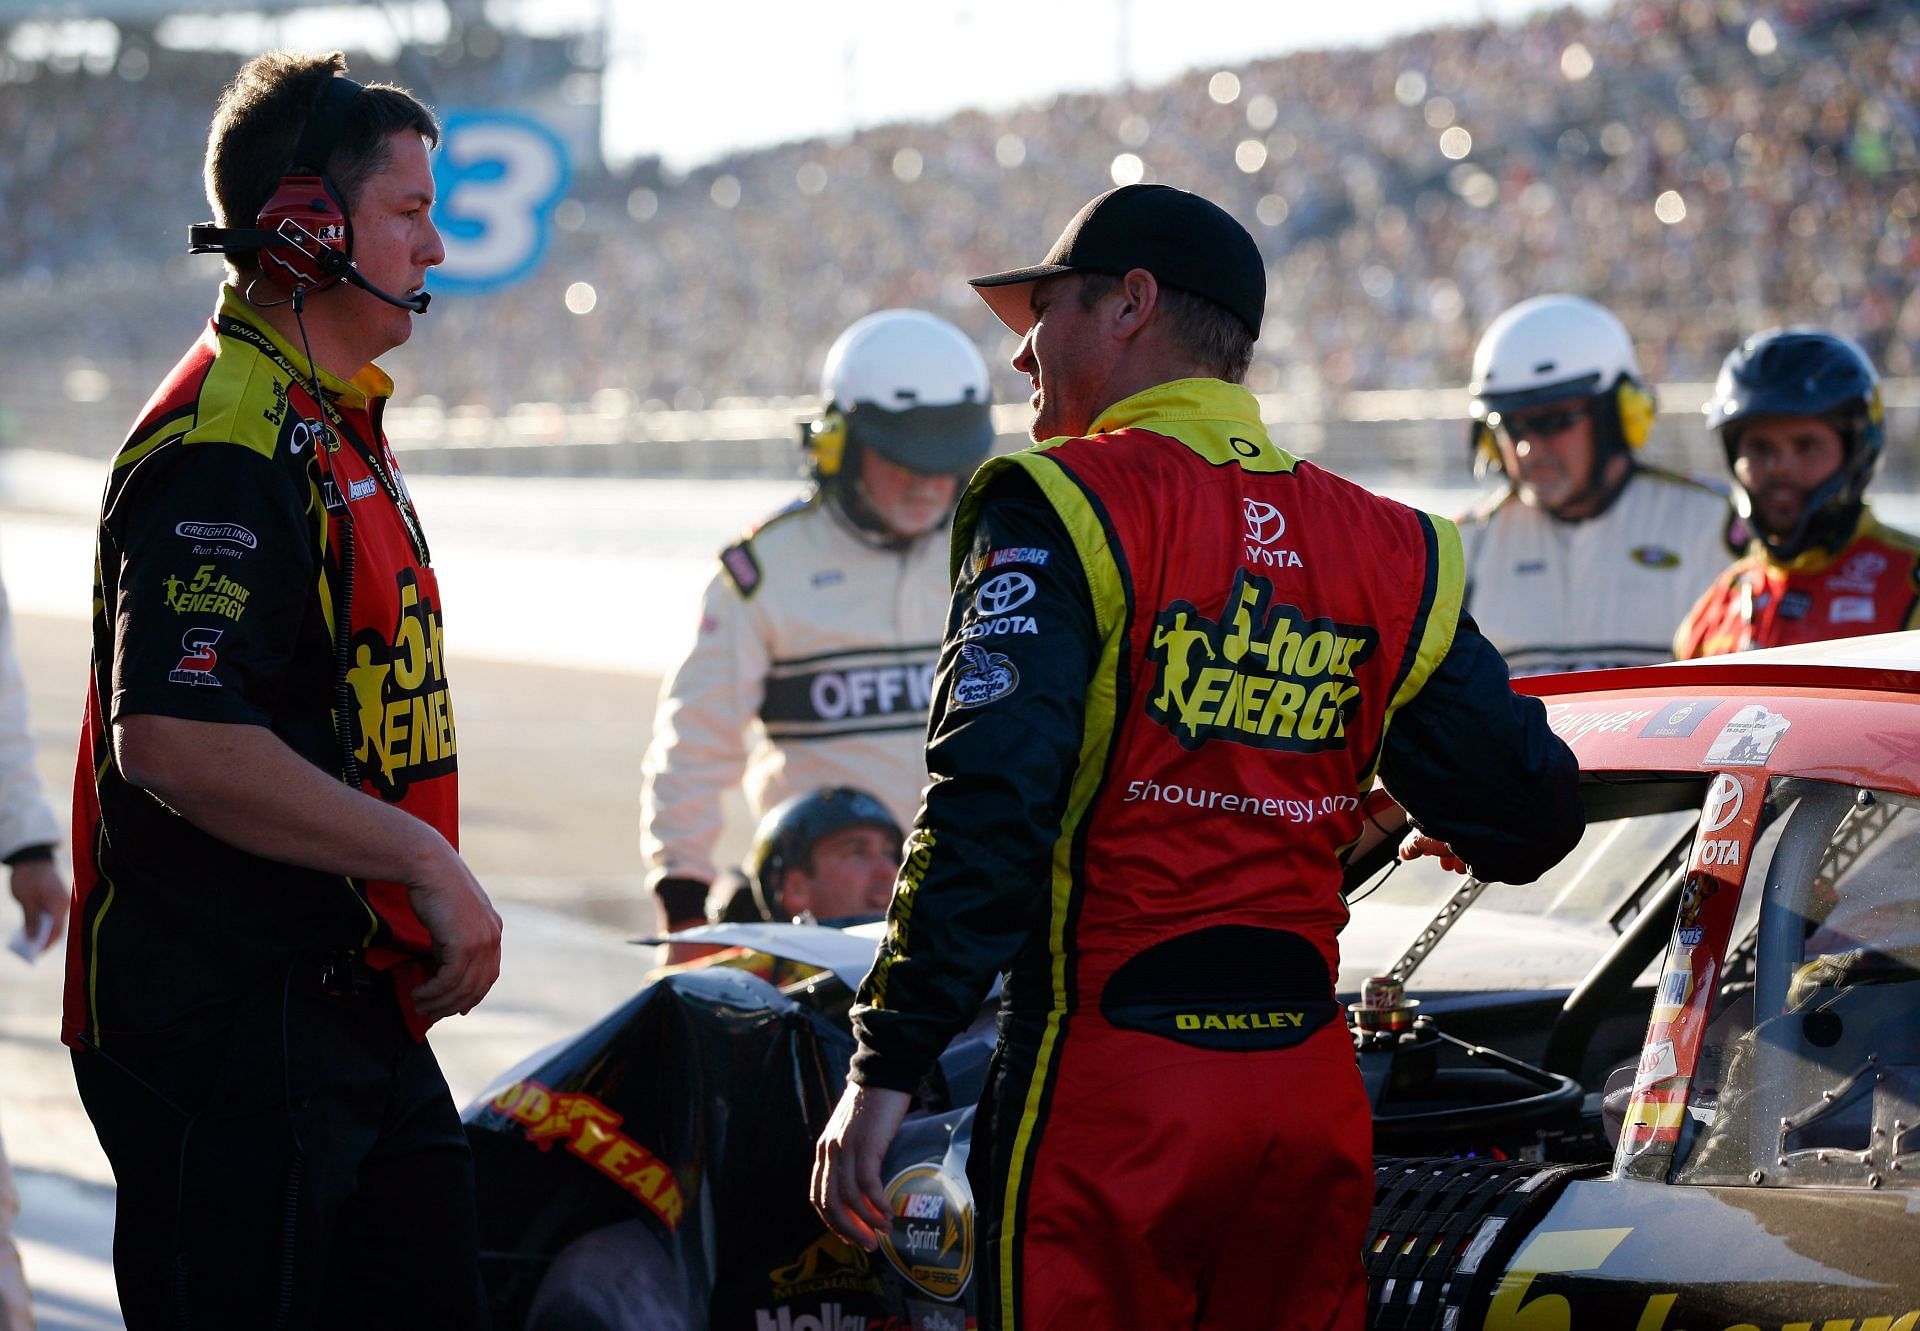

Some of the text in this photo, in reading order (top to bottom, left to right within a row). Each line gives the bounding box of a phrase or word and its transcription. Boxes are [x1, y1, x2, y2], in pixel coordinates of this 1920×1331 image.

[184, 525, 253, 544] FREIGHTLINER
[192, 544, 243, 559] Run Smart
[991, 548, 1049, 566] NASCAR
[1246, 545, 1304, 568] YOTA
[190, 564, 250, 602] 5-hour
[177, 593, 246, 622] ENERGY
[1223, 579, 1367, 678] 5-hour
[1181, 667, 1360, 741] ENERGY
[1175, 1012, 1305, 1031] OAKLEY
[903, 1193, 944, 1220] NASCAR
[906, 1221, 941, 1256] Sprint
